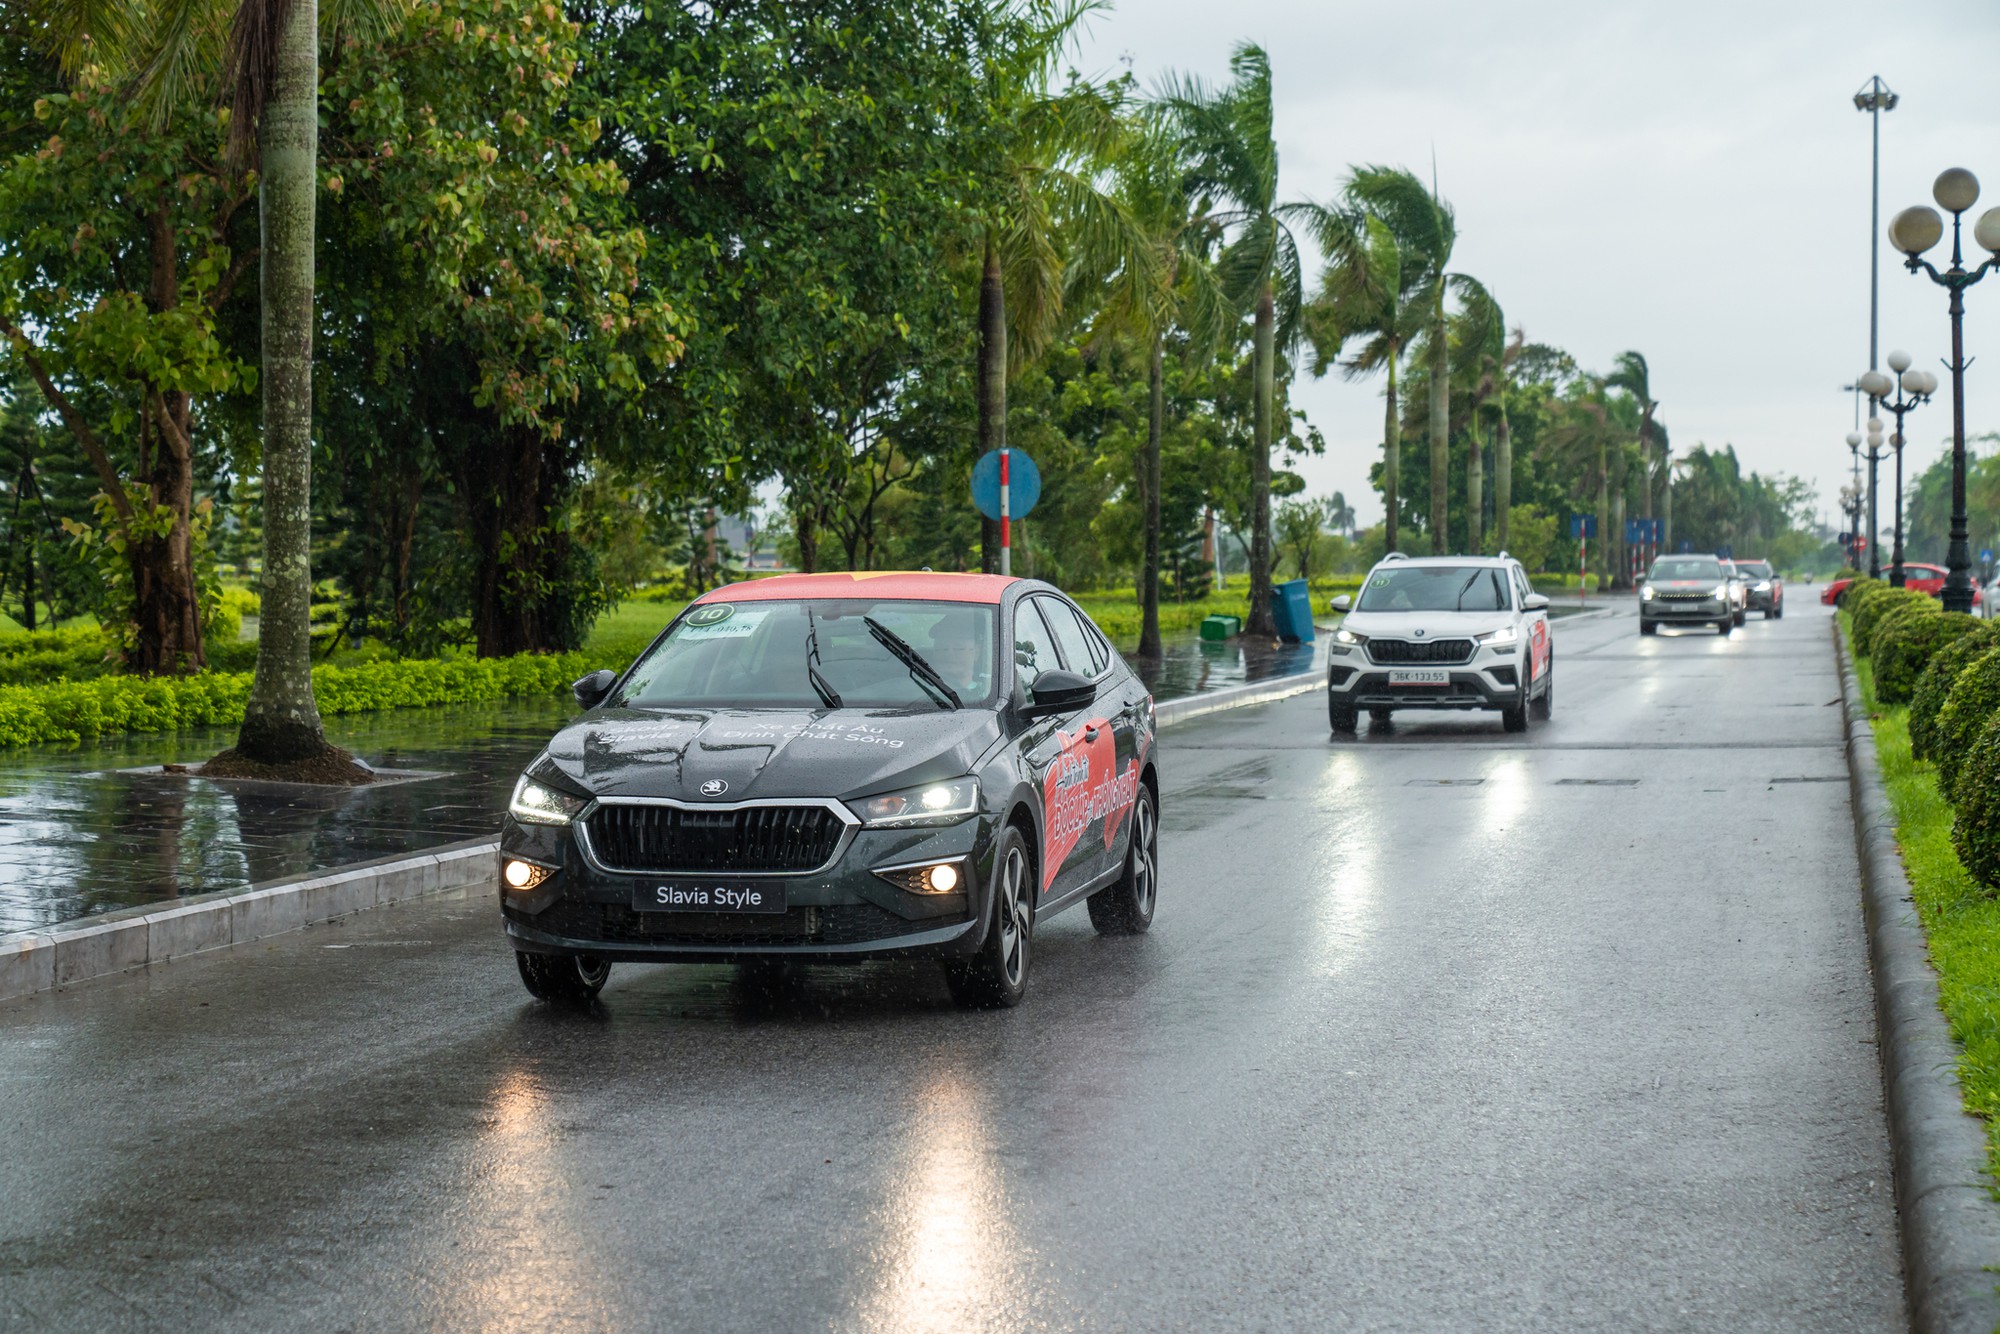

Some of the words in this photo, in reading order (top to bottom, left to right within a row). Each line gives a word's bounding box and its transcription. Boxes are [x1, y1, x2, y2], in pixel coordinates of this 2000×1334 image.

[700, 609, 724, 620] 10
[656, 886, 709, 904] Slavia
[714, 887, 762, 910] Style
